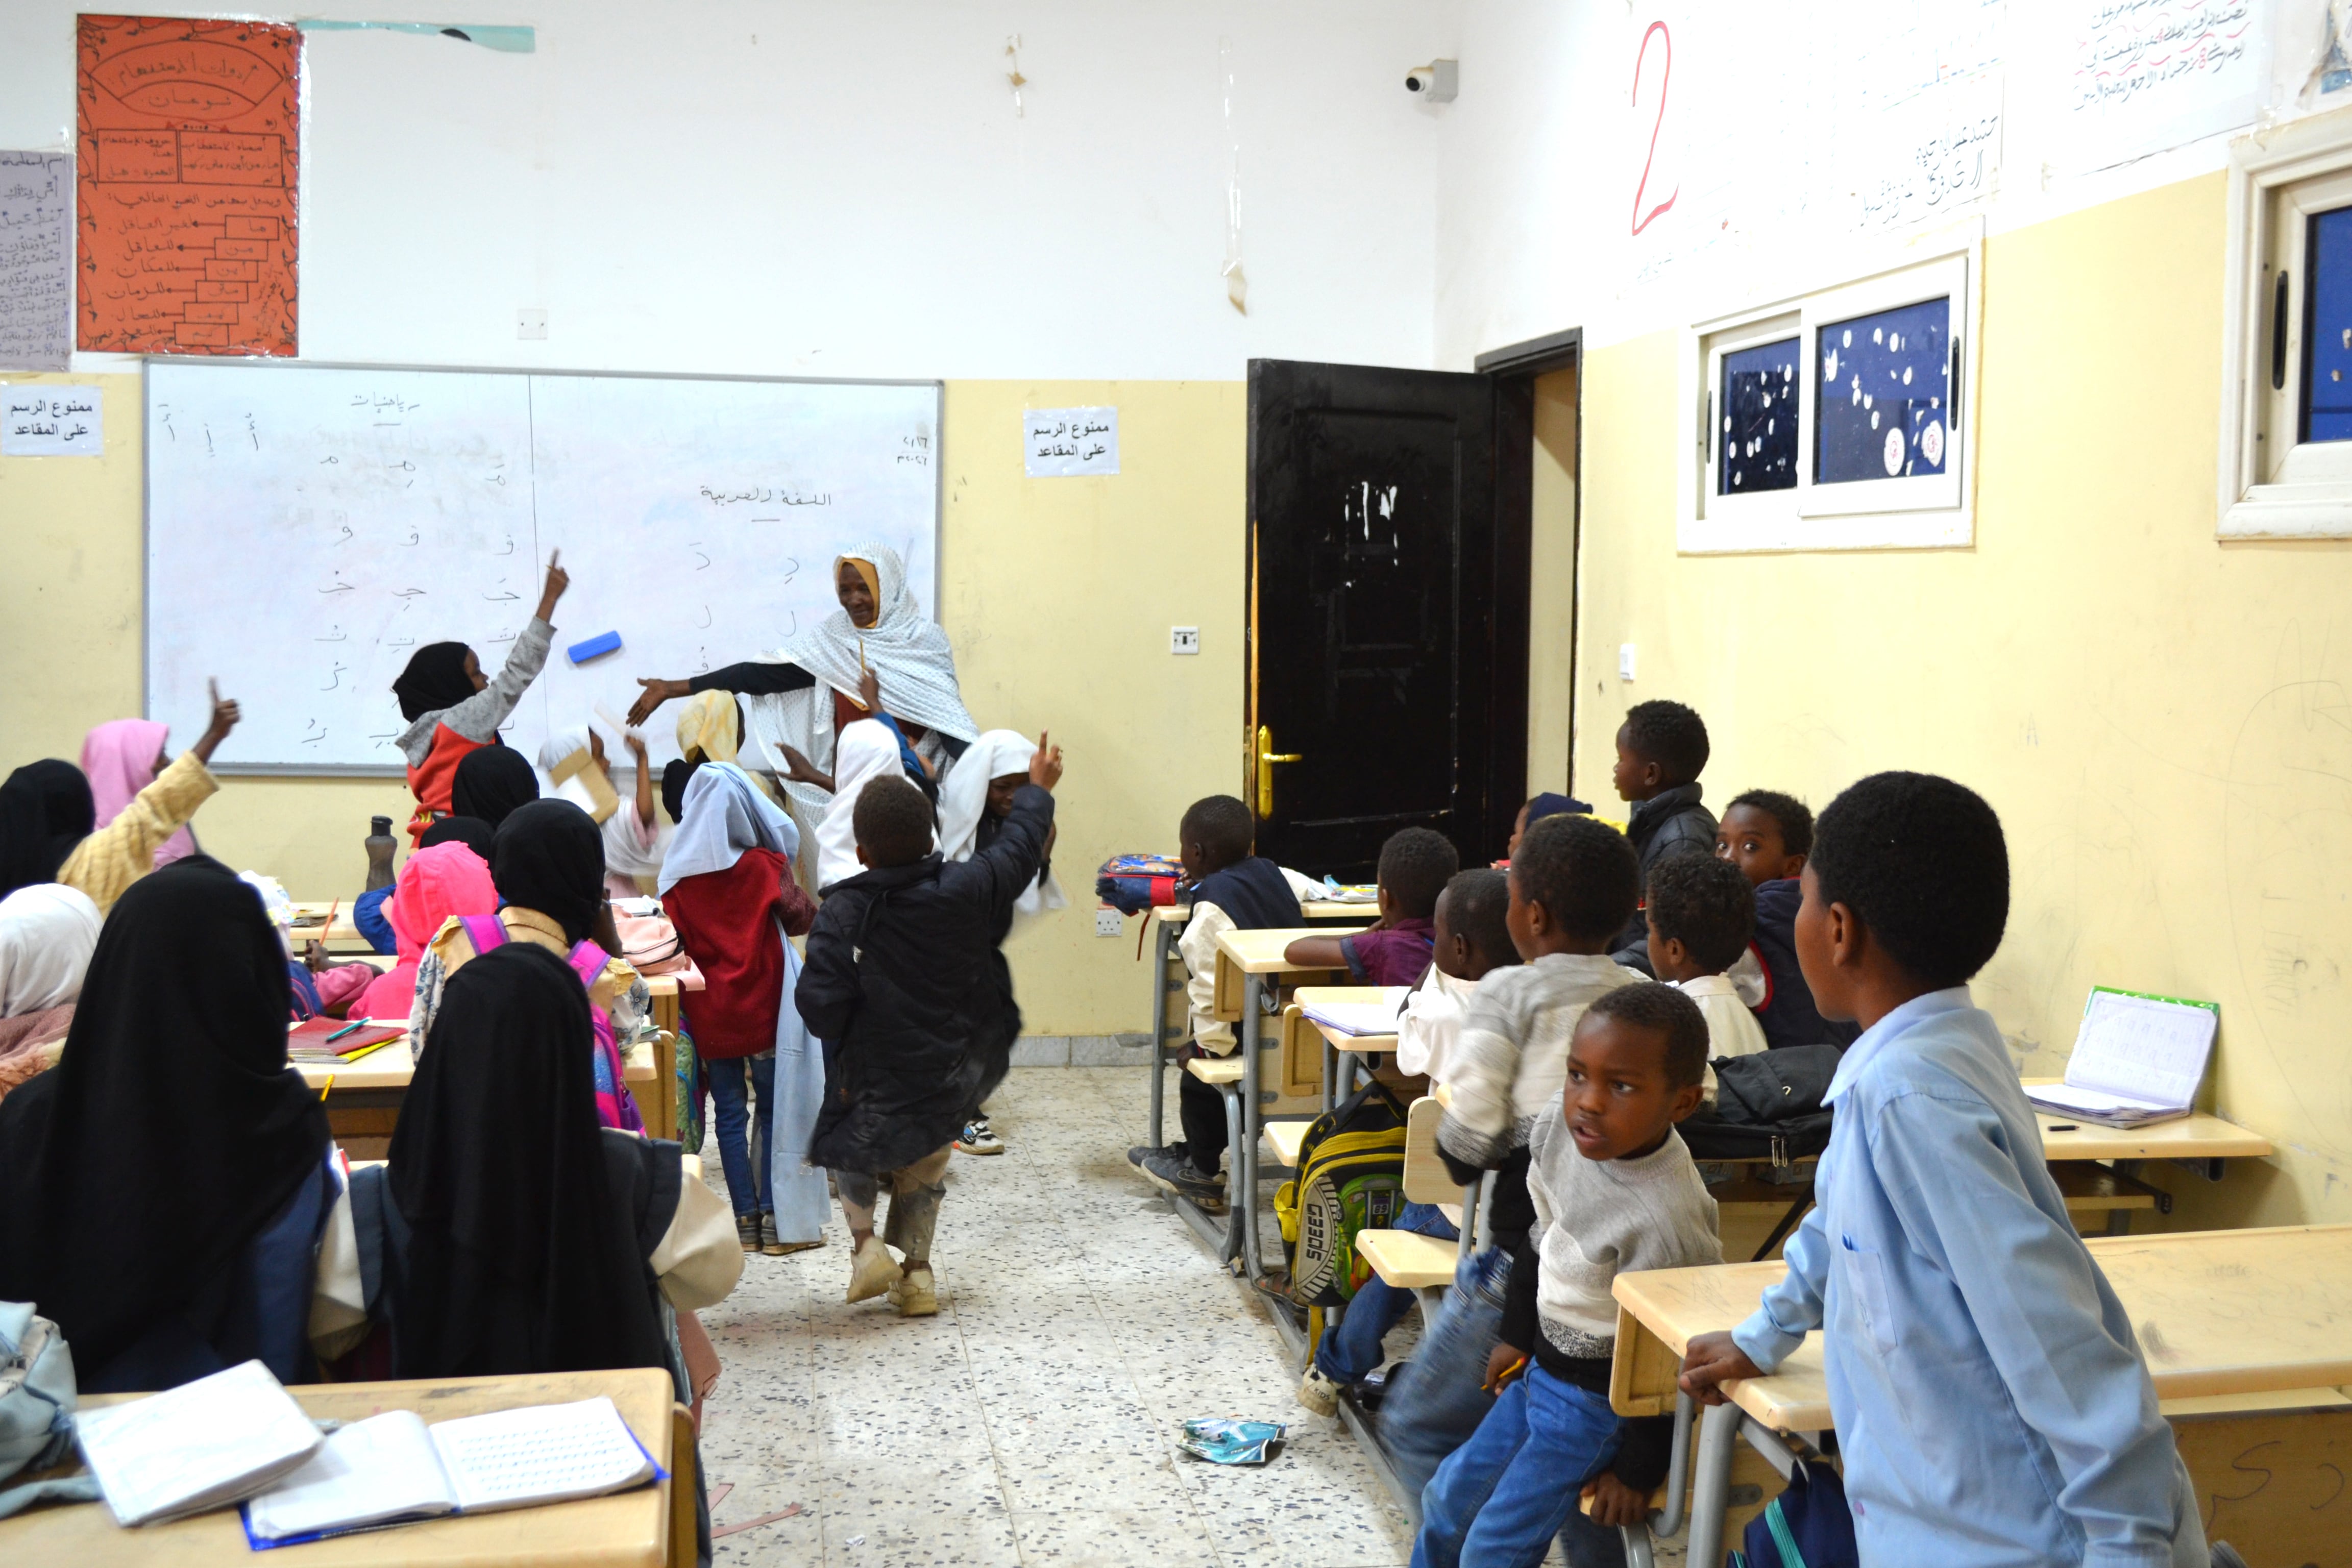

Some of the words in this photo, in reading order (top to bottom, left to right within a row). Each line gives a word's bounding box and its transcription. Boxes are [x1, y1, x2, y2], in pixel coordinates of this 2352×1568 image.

[11, 400, 46, 418] الرسم
[53, 401, 93, 418] ممنوع
[15, 423, 58, 436] المقاعد
[64, 424, 88, 440] على
[1033, 423, 1066, 440] الرسم
[1071, 422, 1109, 438] ممنوع
[1038, 444, 1078, 457] المقاعد
[1083, 444, 1106, 460] على
